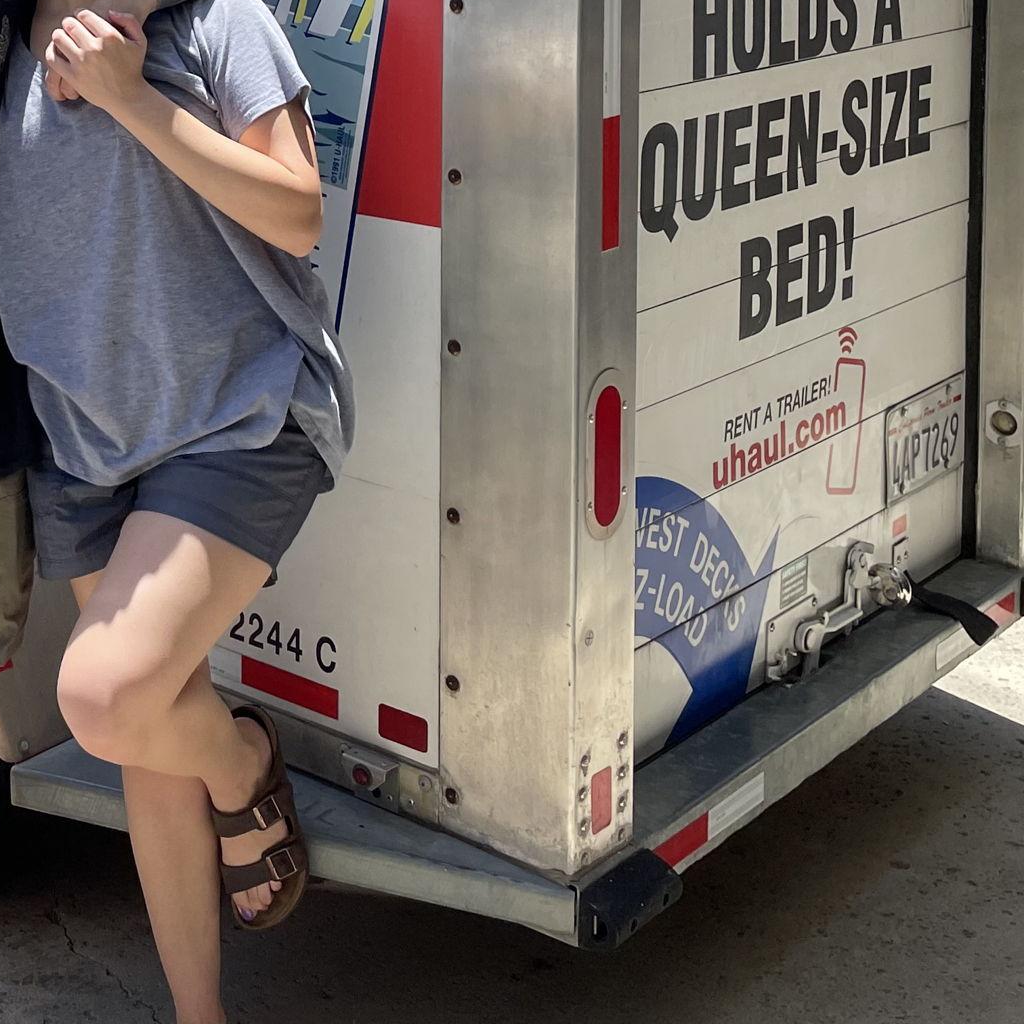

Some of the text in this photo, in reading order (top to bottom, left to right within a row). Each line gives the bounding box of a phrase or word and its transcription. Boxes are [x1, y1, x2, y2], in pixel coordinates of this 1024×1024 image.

[639, 65, 932, 243] QUEEN-SIZE
[738, 206, 854, 342] BED!
[712, 401, 846, 490] uhaul.com
[724, 374, 832, 442] RENT A TRAILER!
[689, 531, 746, 632] DECKS
[229, 611, 337, 674] 2244 C
